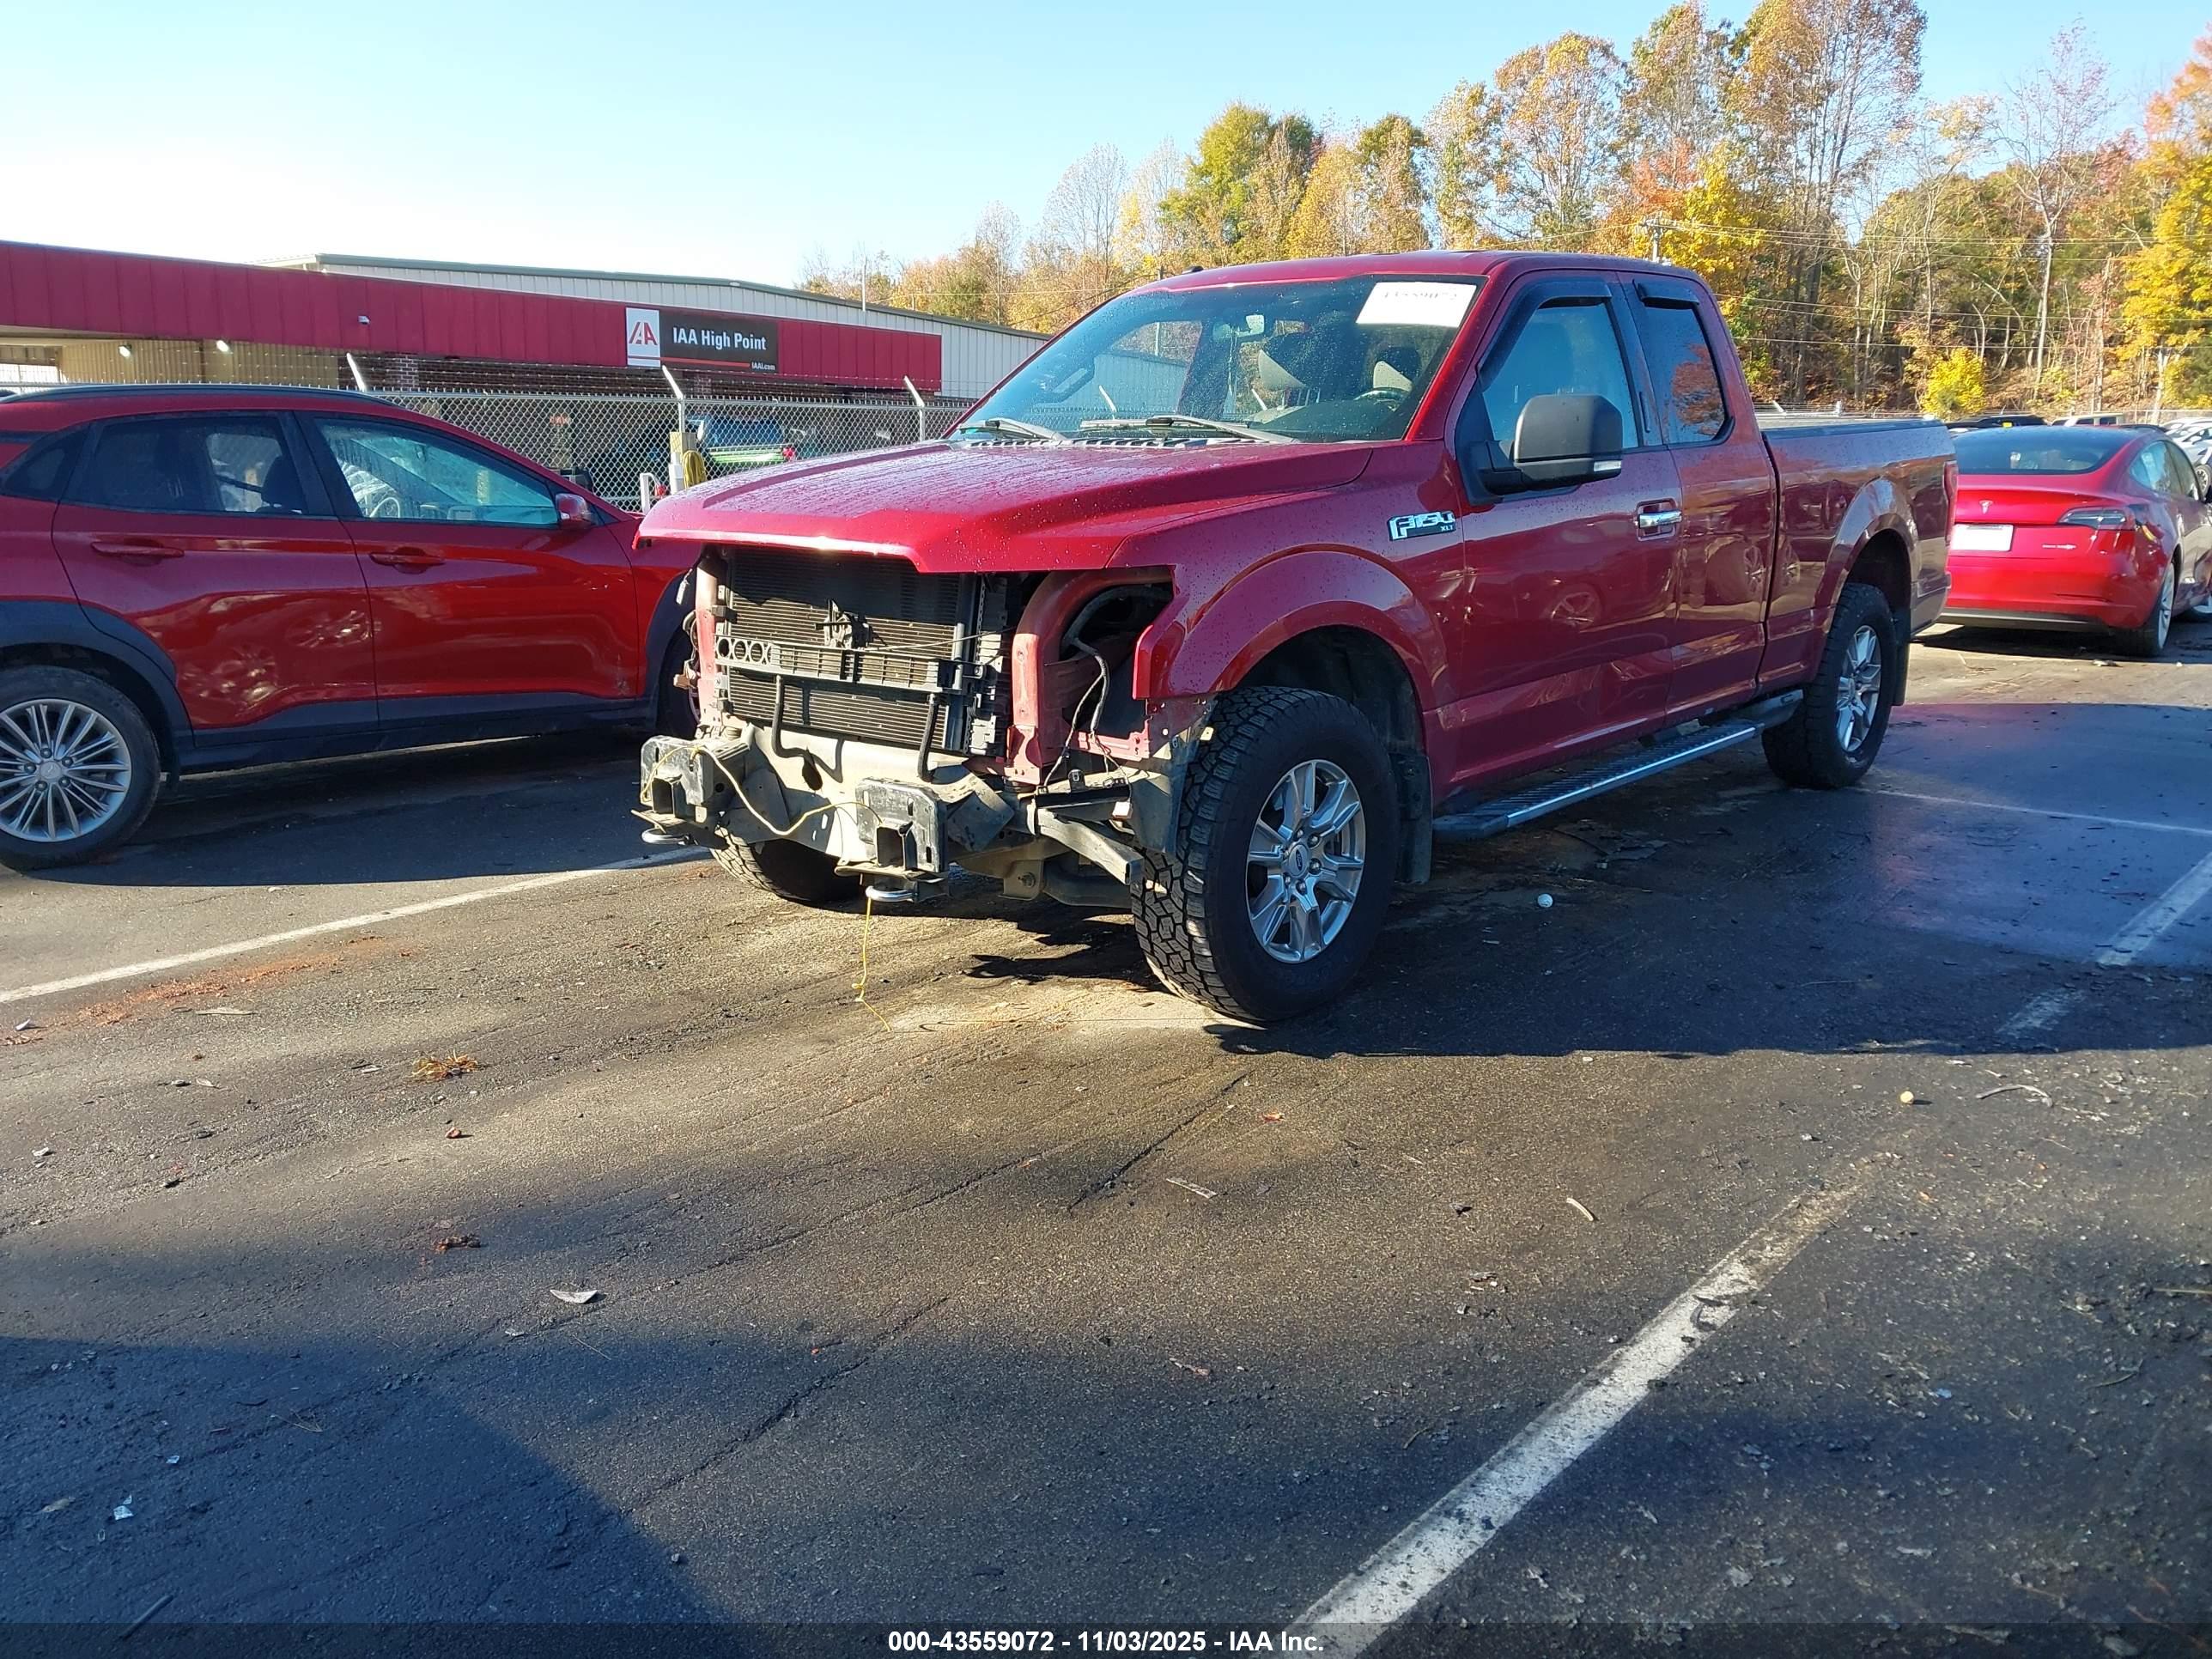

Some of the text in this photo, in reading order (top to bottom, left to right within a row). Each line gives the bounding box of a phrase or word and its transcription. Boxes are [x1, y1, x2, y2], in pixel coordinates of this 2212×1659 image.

[672, 327, 767, 350] IAA High Point
